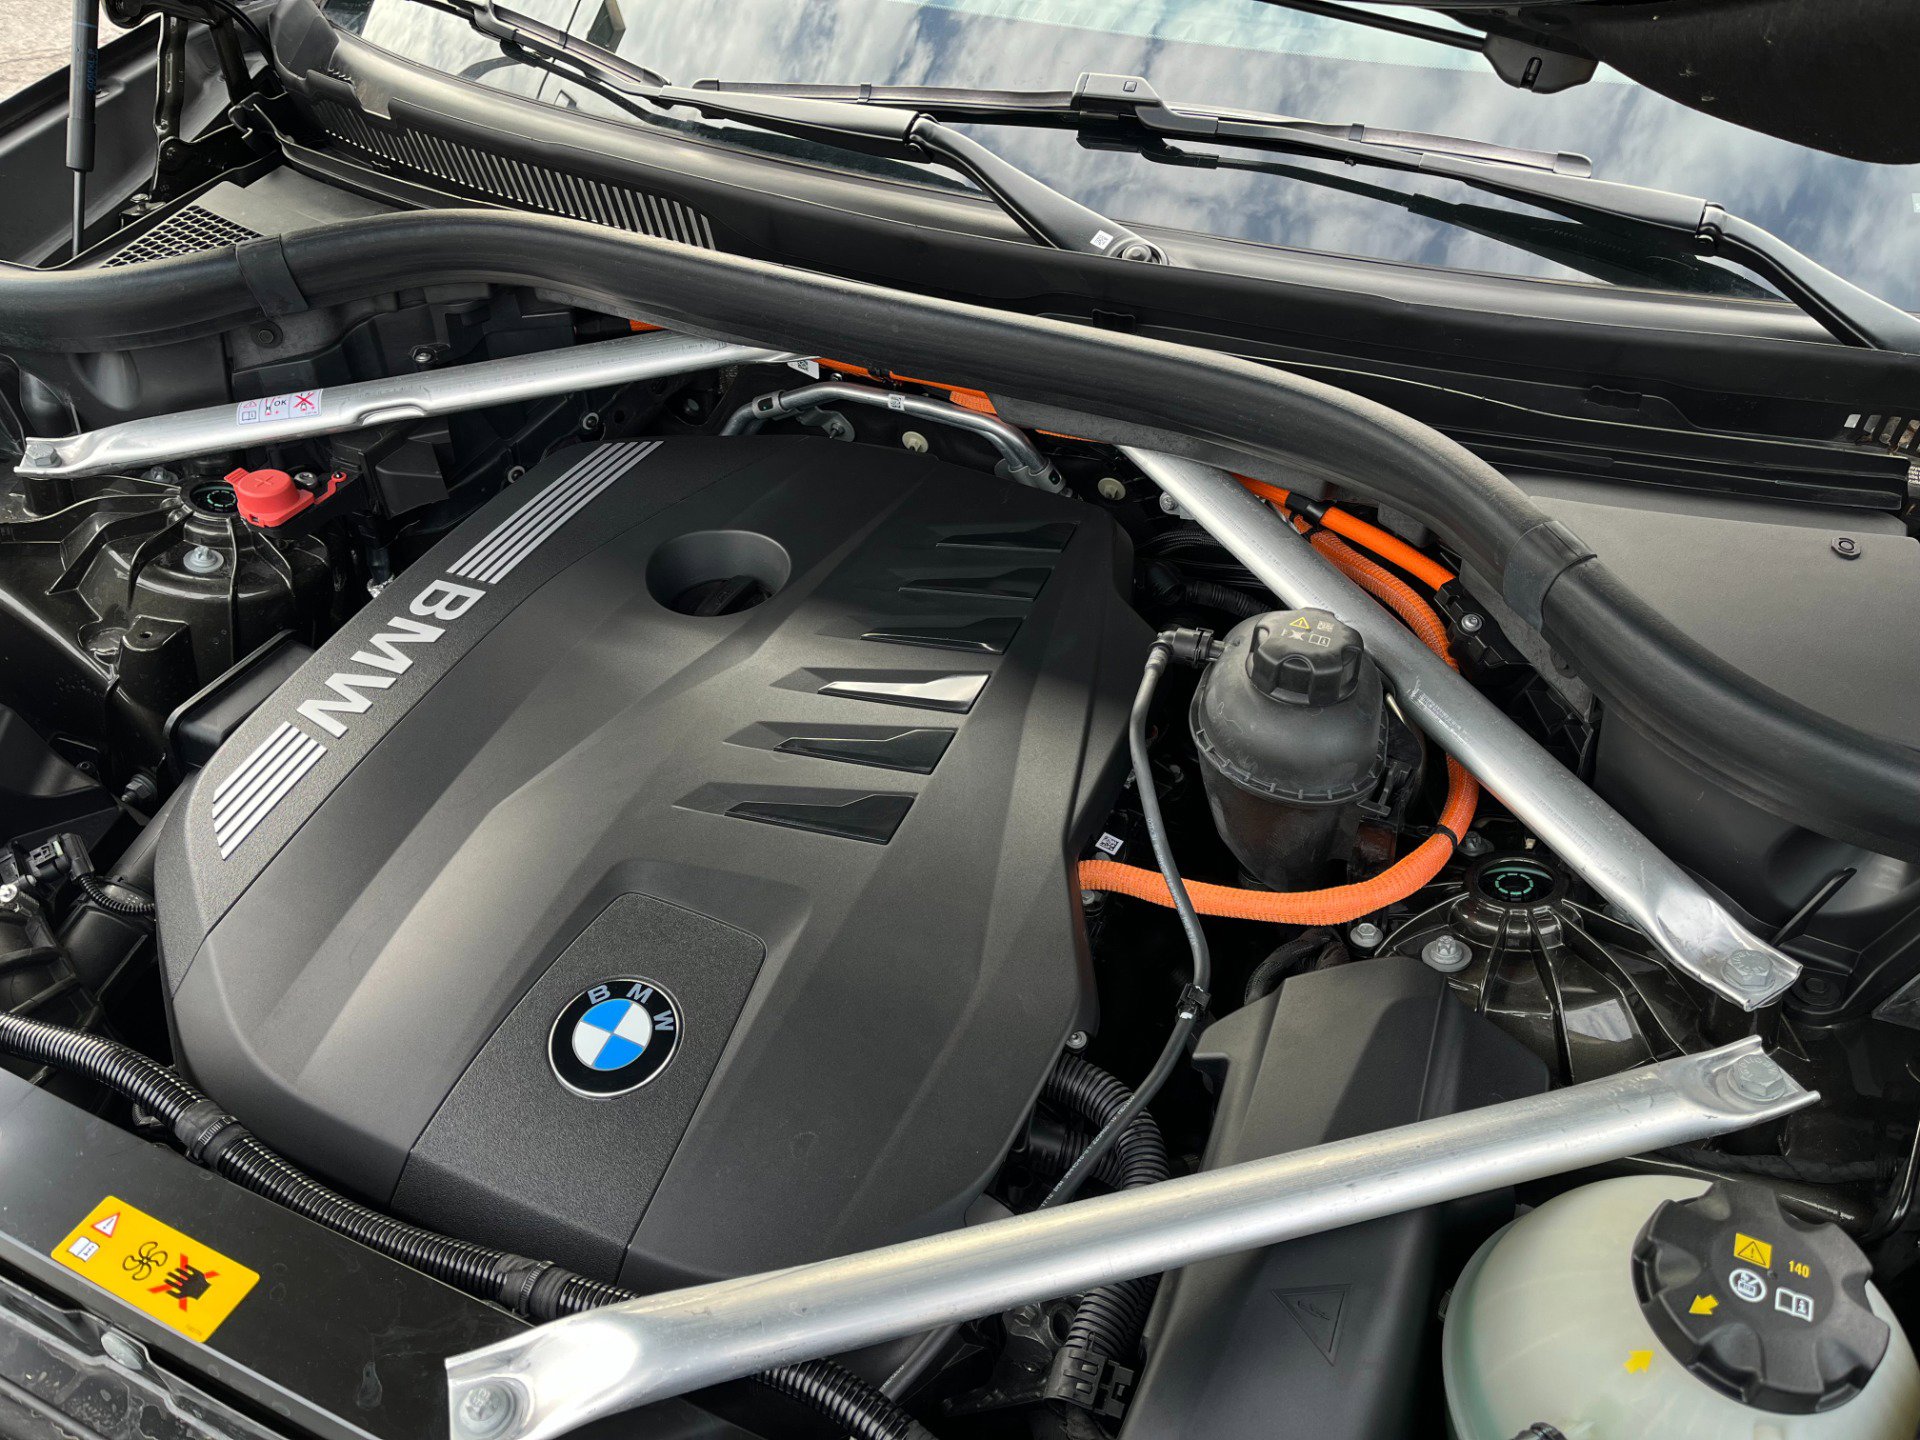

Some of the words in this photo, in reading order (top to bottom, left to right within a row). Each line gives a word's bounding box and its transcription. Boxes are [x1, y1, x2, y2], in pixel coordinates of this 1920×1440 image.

[274, 399, 287, 407] OK
[296, 579, 487, 739] BMW
[587, 983, 674, 1031] BMW
[1789, 1260, 1810, 1278] 140
